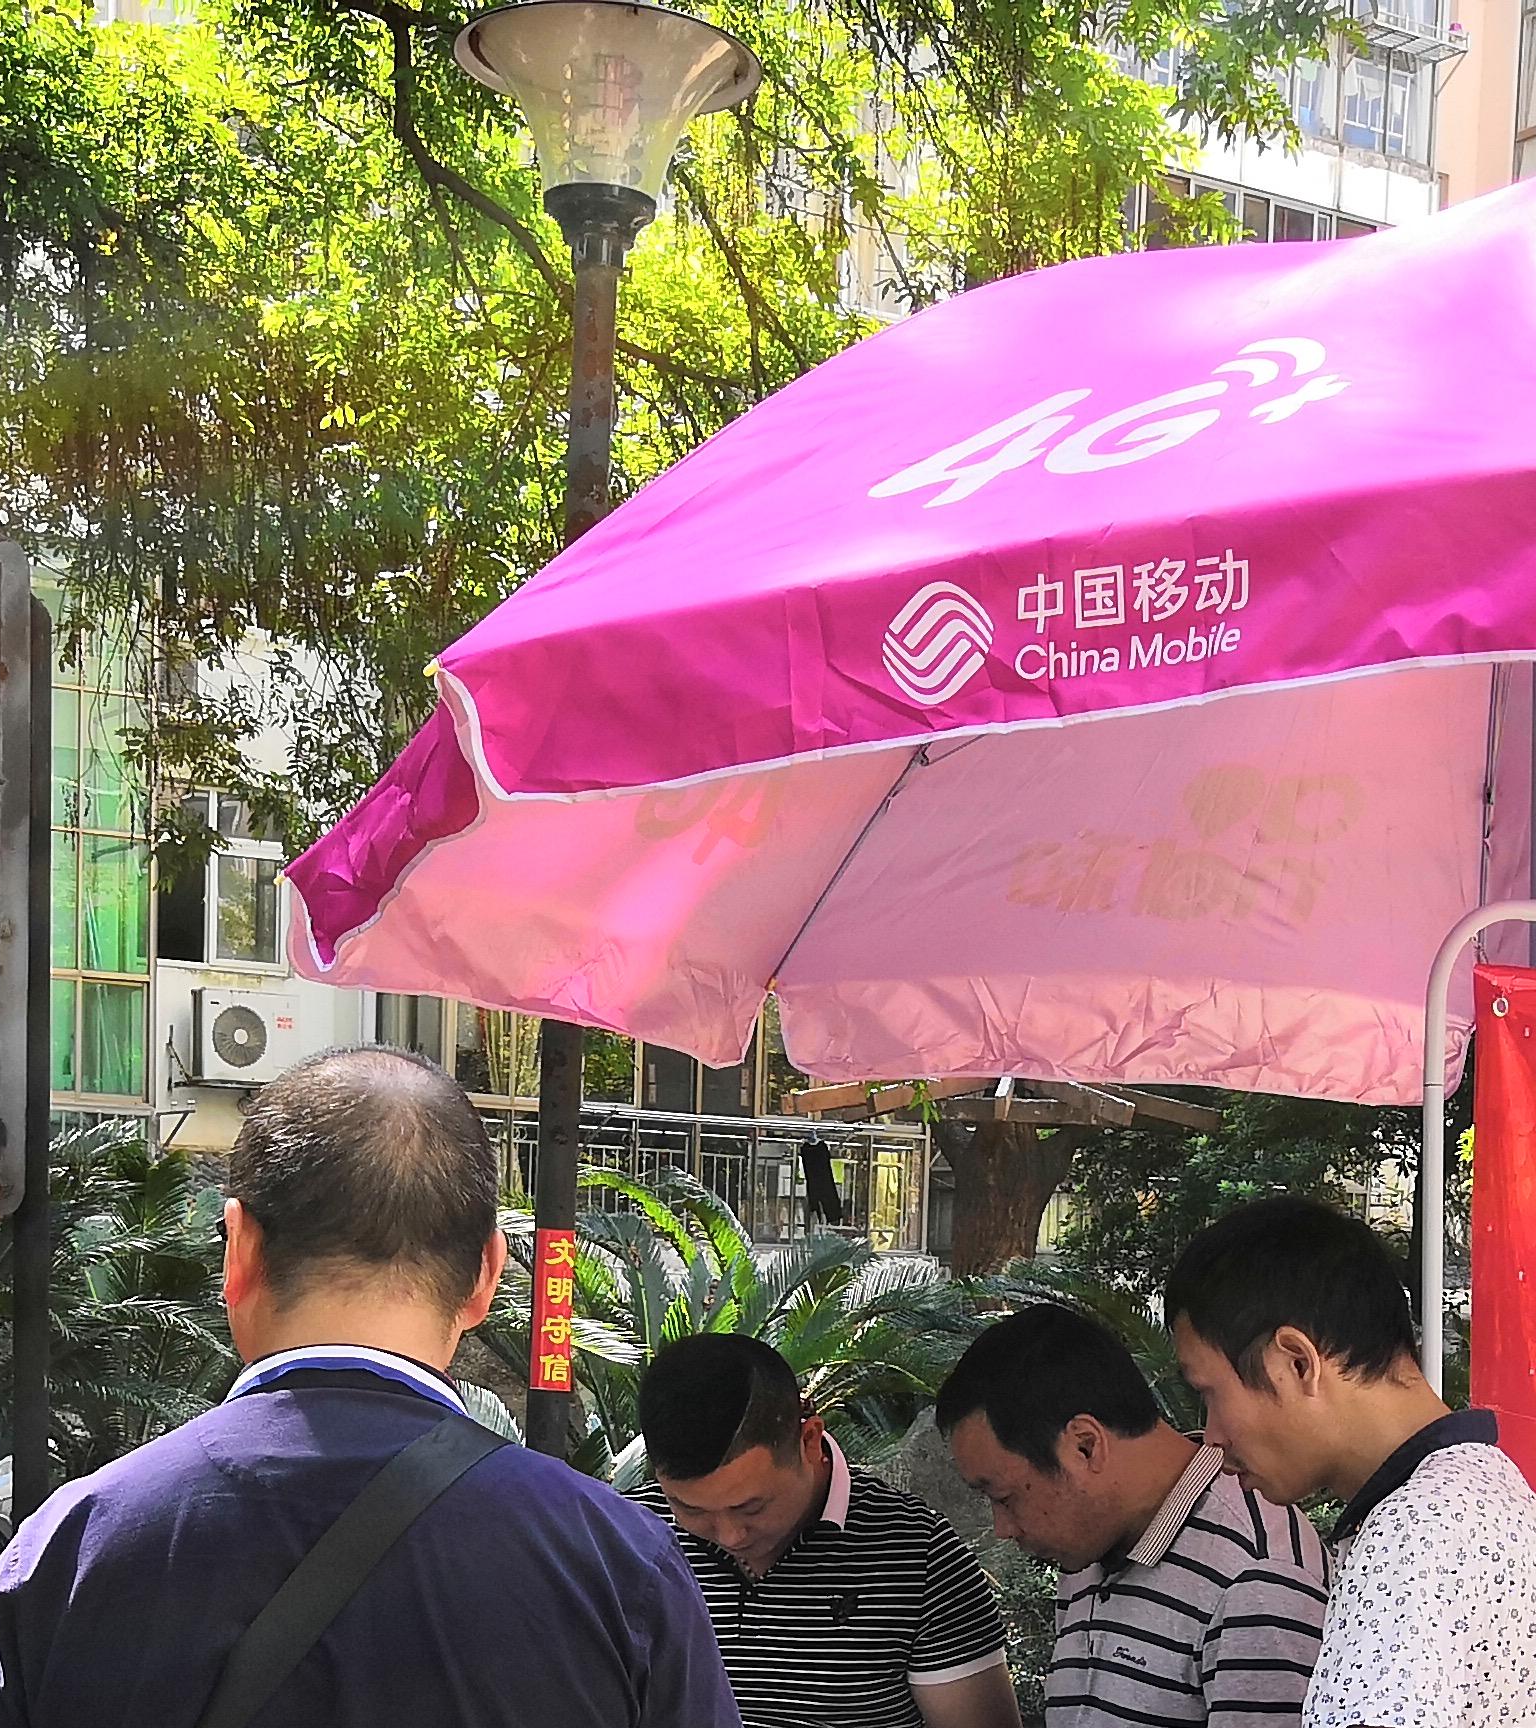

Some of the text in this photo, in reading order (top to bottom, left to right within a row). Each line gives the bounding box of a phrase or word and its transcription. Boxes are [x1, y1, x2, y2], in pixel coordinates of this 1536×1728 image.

[1017, 549, 1250, 634] 中国移动
[1015, 621, 1242, 681] China Mobile
[540, 1237, 575, 1382] 文明守信
